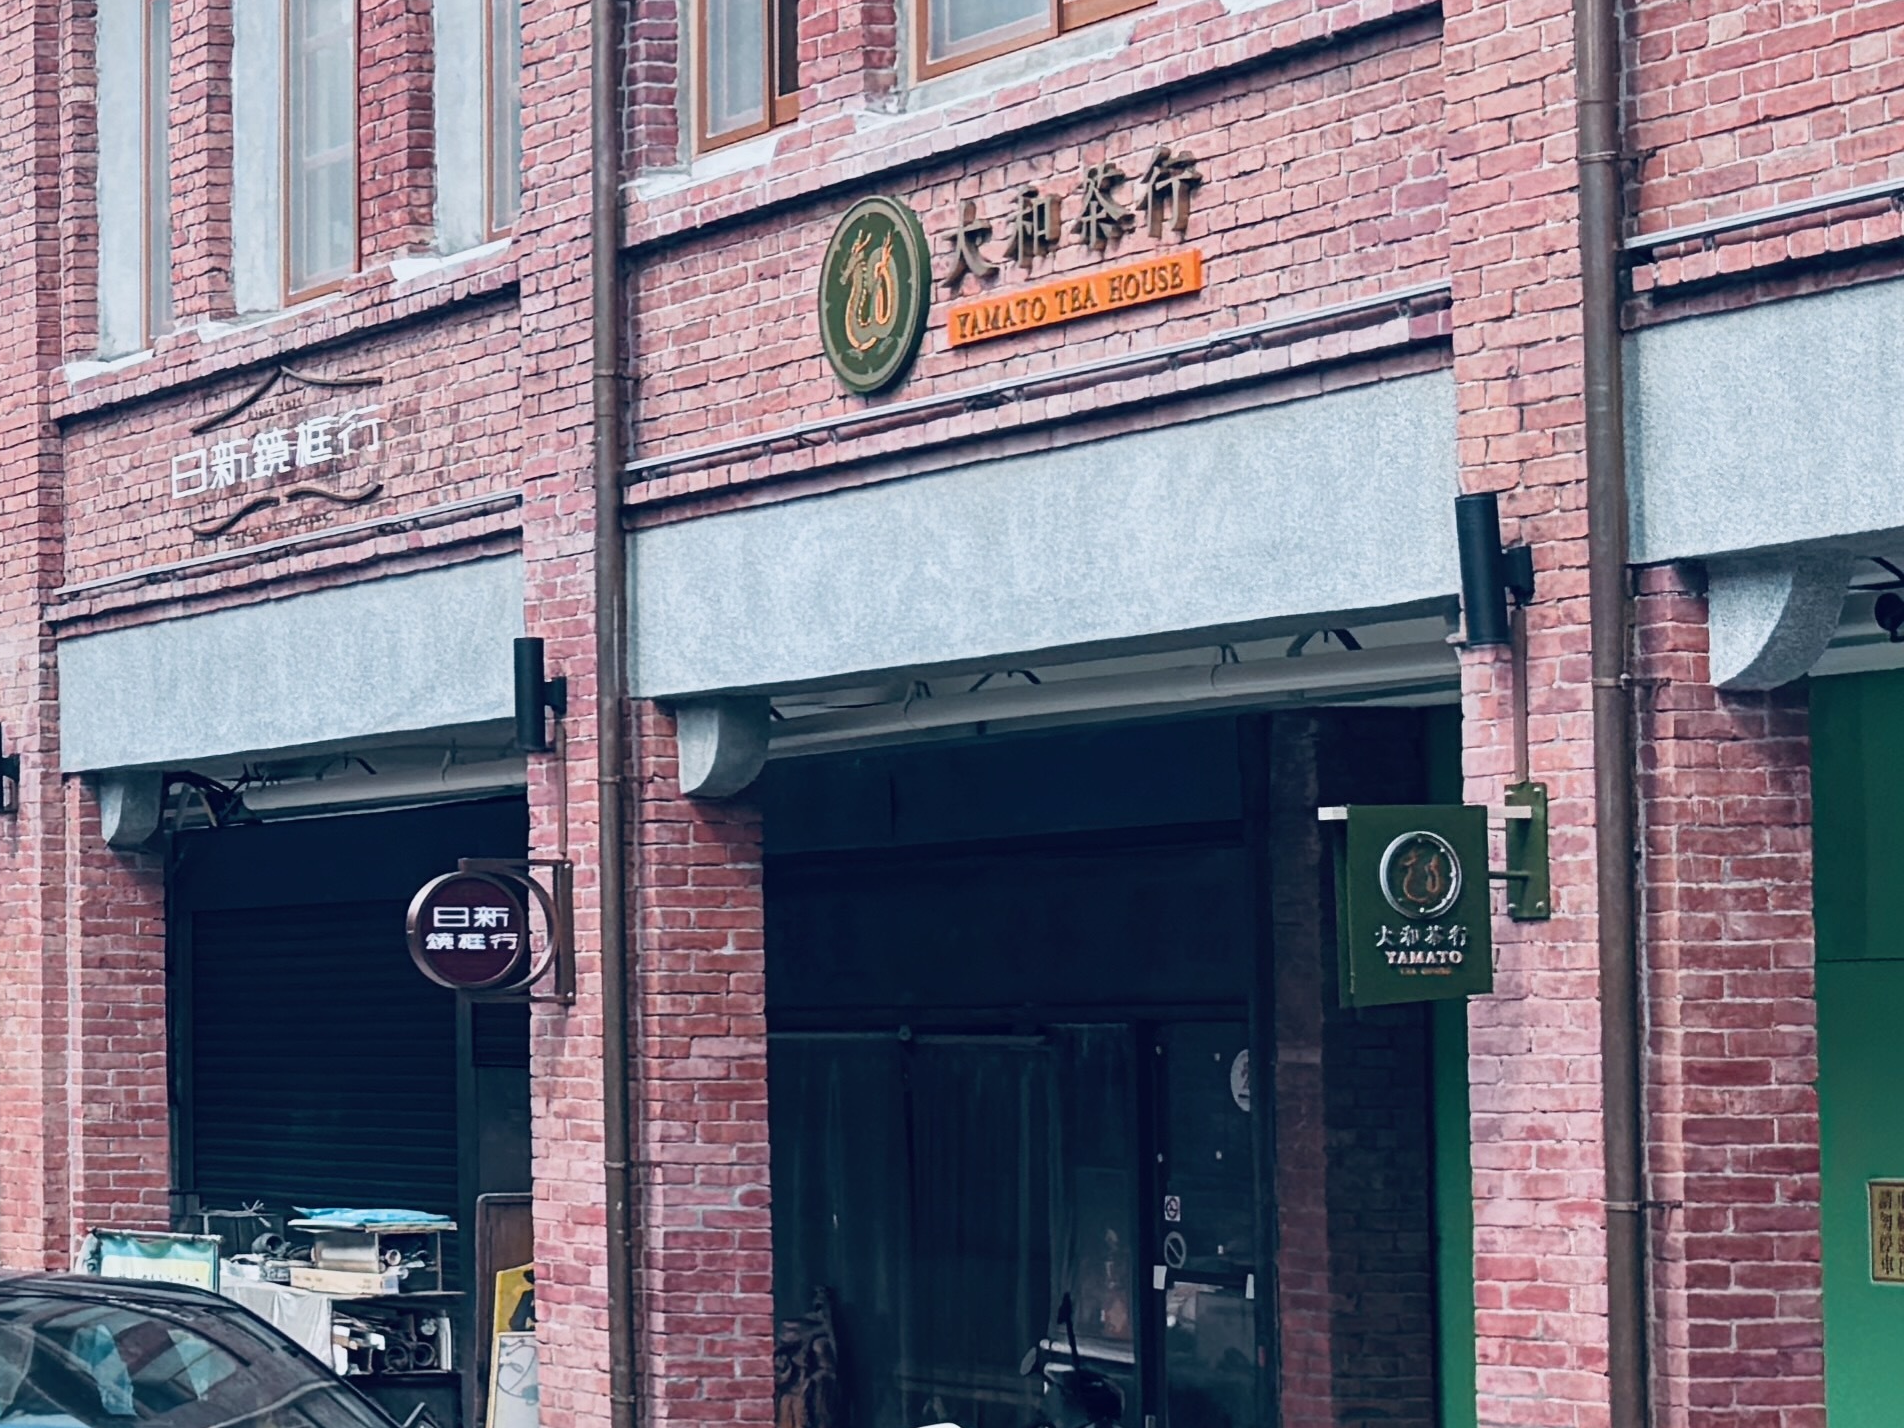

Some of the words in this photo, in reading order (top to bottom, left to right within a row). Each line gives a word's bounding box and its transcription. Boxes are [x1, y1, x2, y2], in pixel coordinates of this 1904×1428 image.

[942, 145, 1203, 289] 大和茶行
[955, 295, 1046, 339] YAMATO
[1054, 285, 1098, 315] TEA
[1108, 262, 1184, 302] HOUSE
[171, 403, 387, 500] 日新鏡框行
[433, 906, 510, 928] 日新
[425, 932, 519, 950] 鏡框行
[1375, 924, 1468, 947] 大和茶行
[1384, 950, 1464, 965] YAMATO
